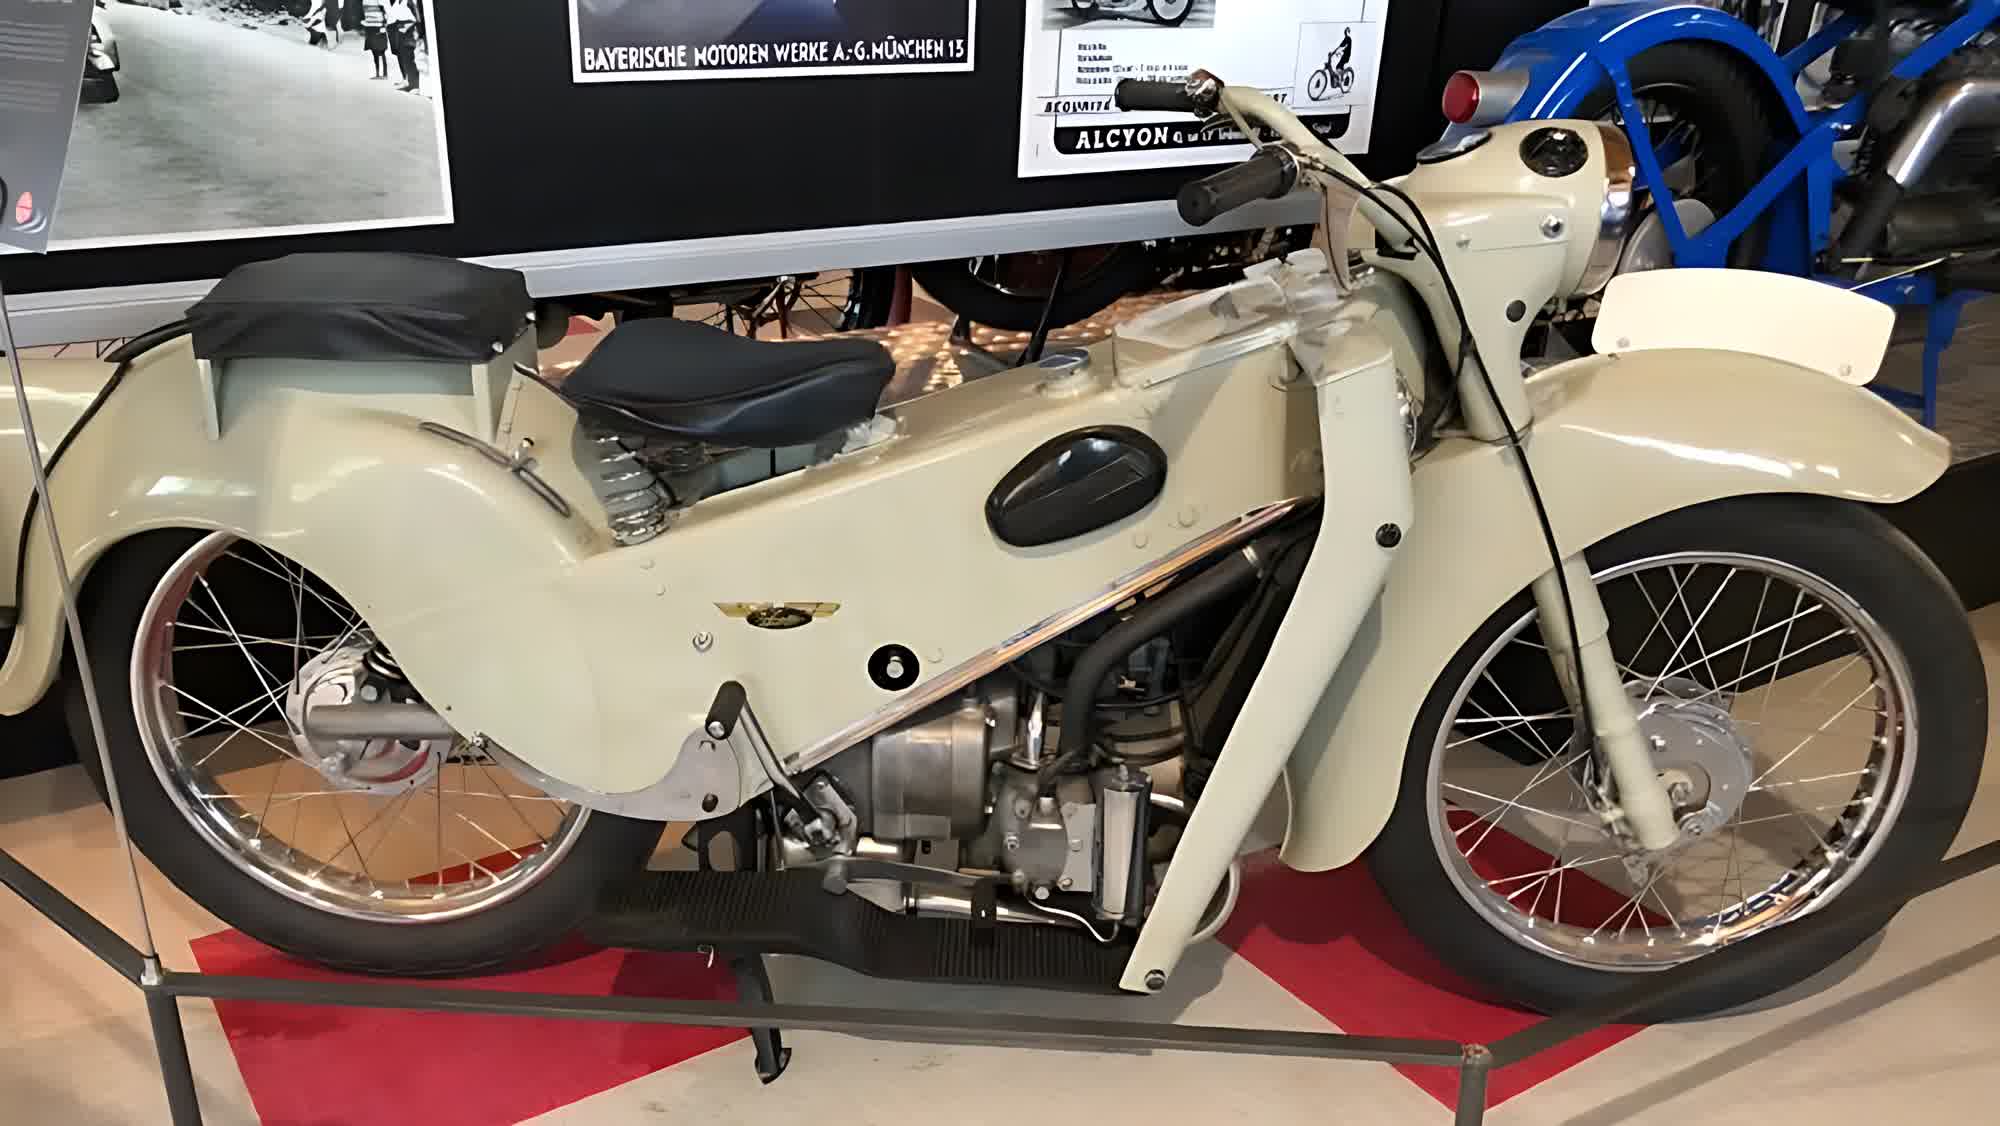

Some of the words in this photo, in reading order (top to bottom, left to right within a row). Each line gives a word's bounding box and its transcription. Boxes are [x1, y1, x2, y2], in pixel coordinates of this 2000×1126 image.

[584, 45, 688, 71] BAYERISCHE
[694, 43, 769, 67] MOTOREN
[773, 40, 829, 64] WERKE
[1075, 126, 1169, 150] ALCYON
